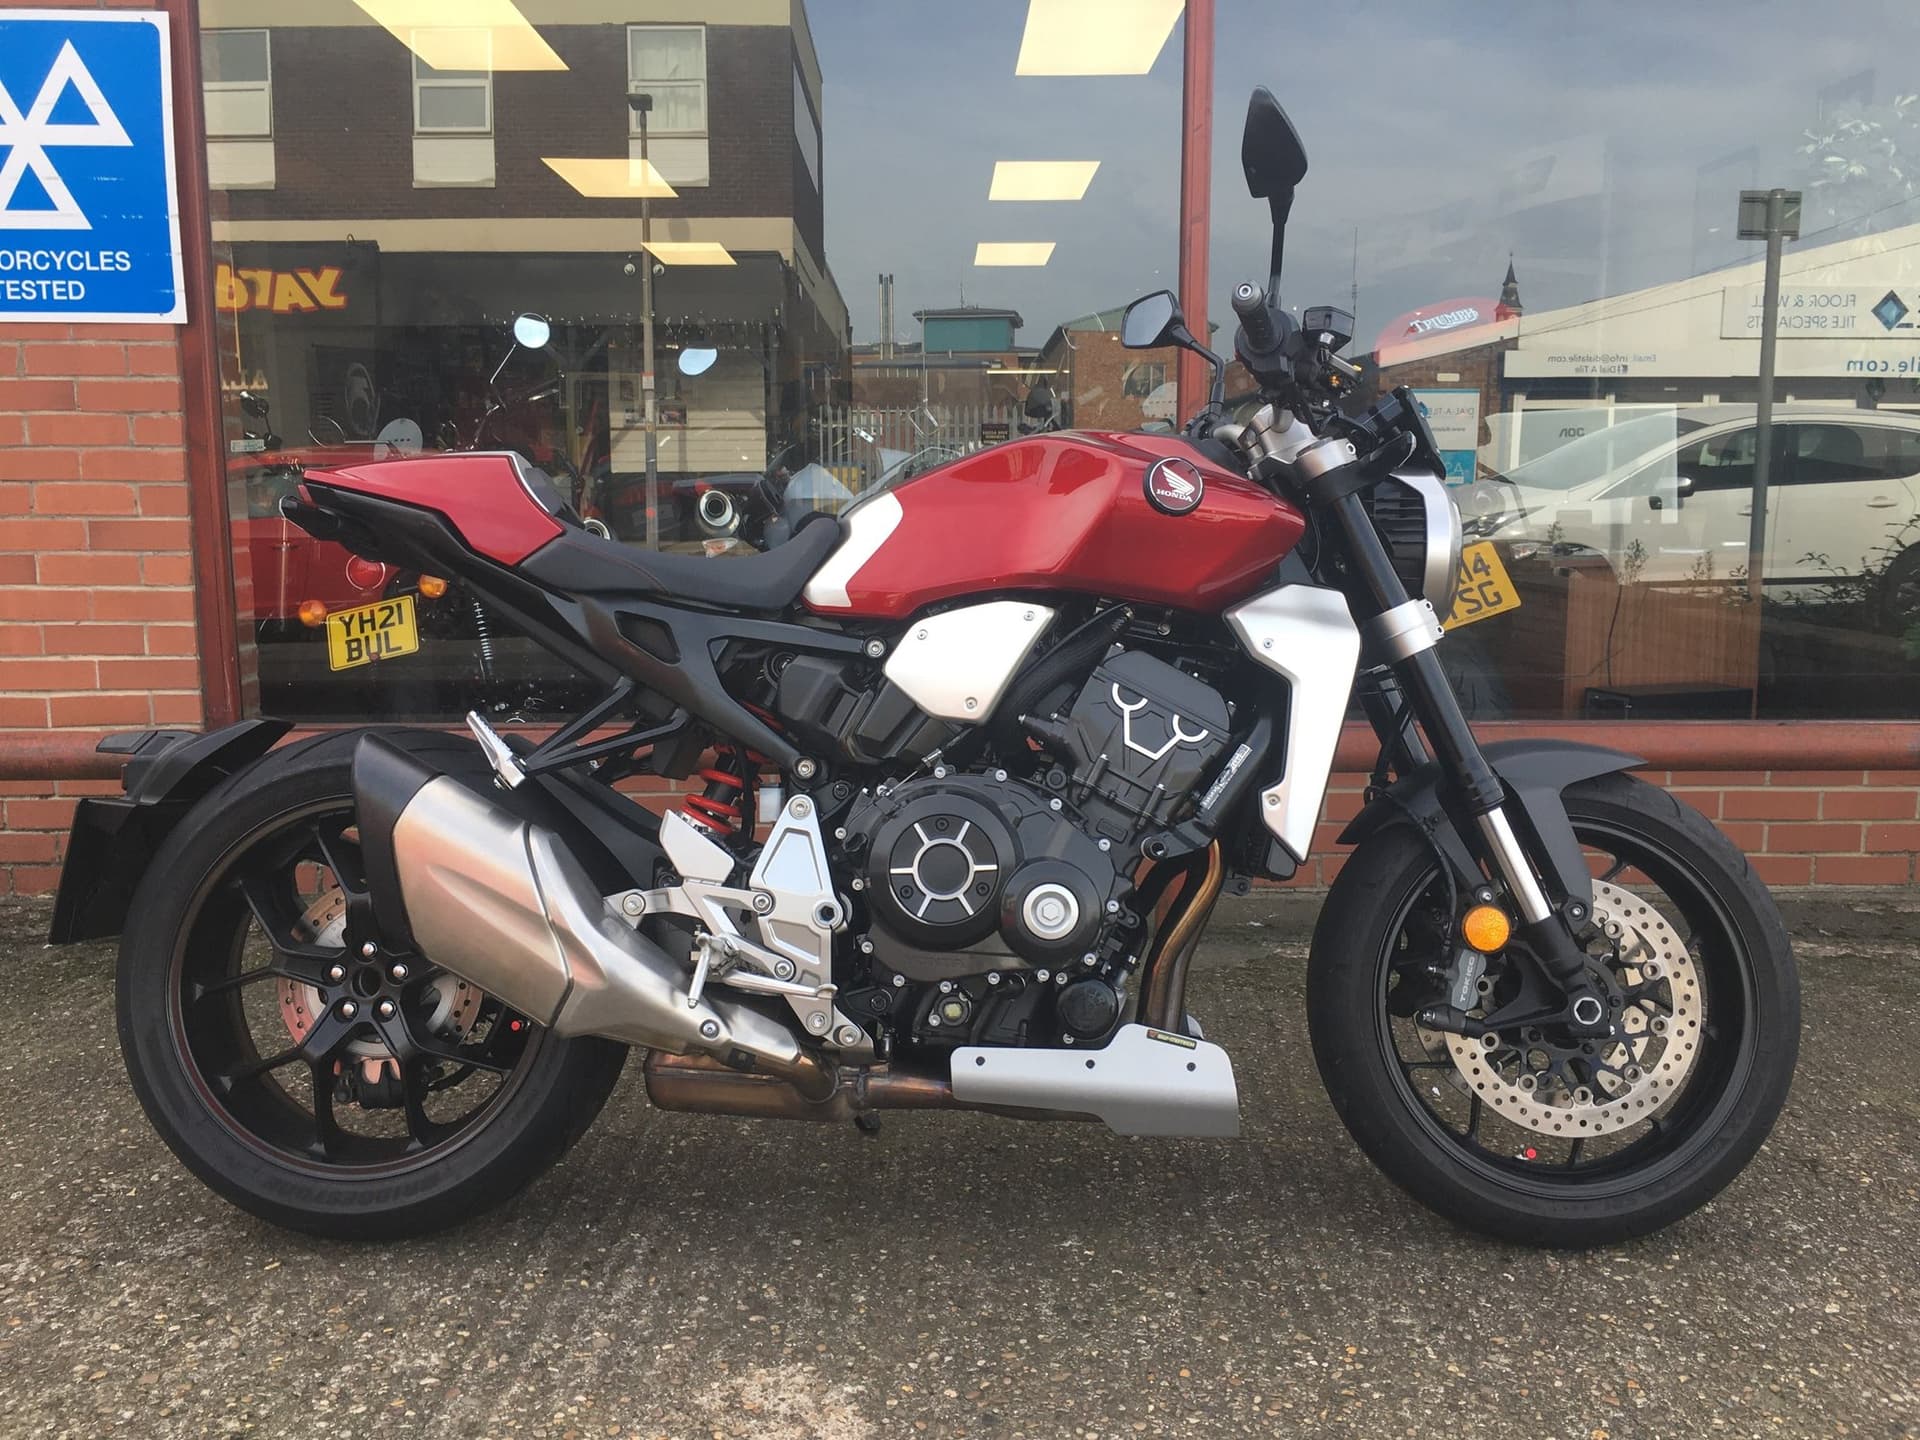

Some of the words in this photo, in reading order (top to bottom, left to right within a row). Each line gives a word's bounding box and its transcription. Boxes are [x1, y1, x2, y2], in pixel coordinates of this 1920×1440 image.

[0, 280, 86, 300] ESTED
[1156, 488, 1193, 502] HONDA
[339, 602, 404, 637] YH21
[345, 631, 403, 663] BUL
[1460, 956, 1475, 1002] TOKICO
